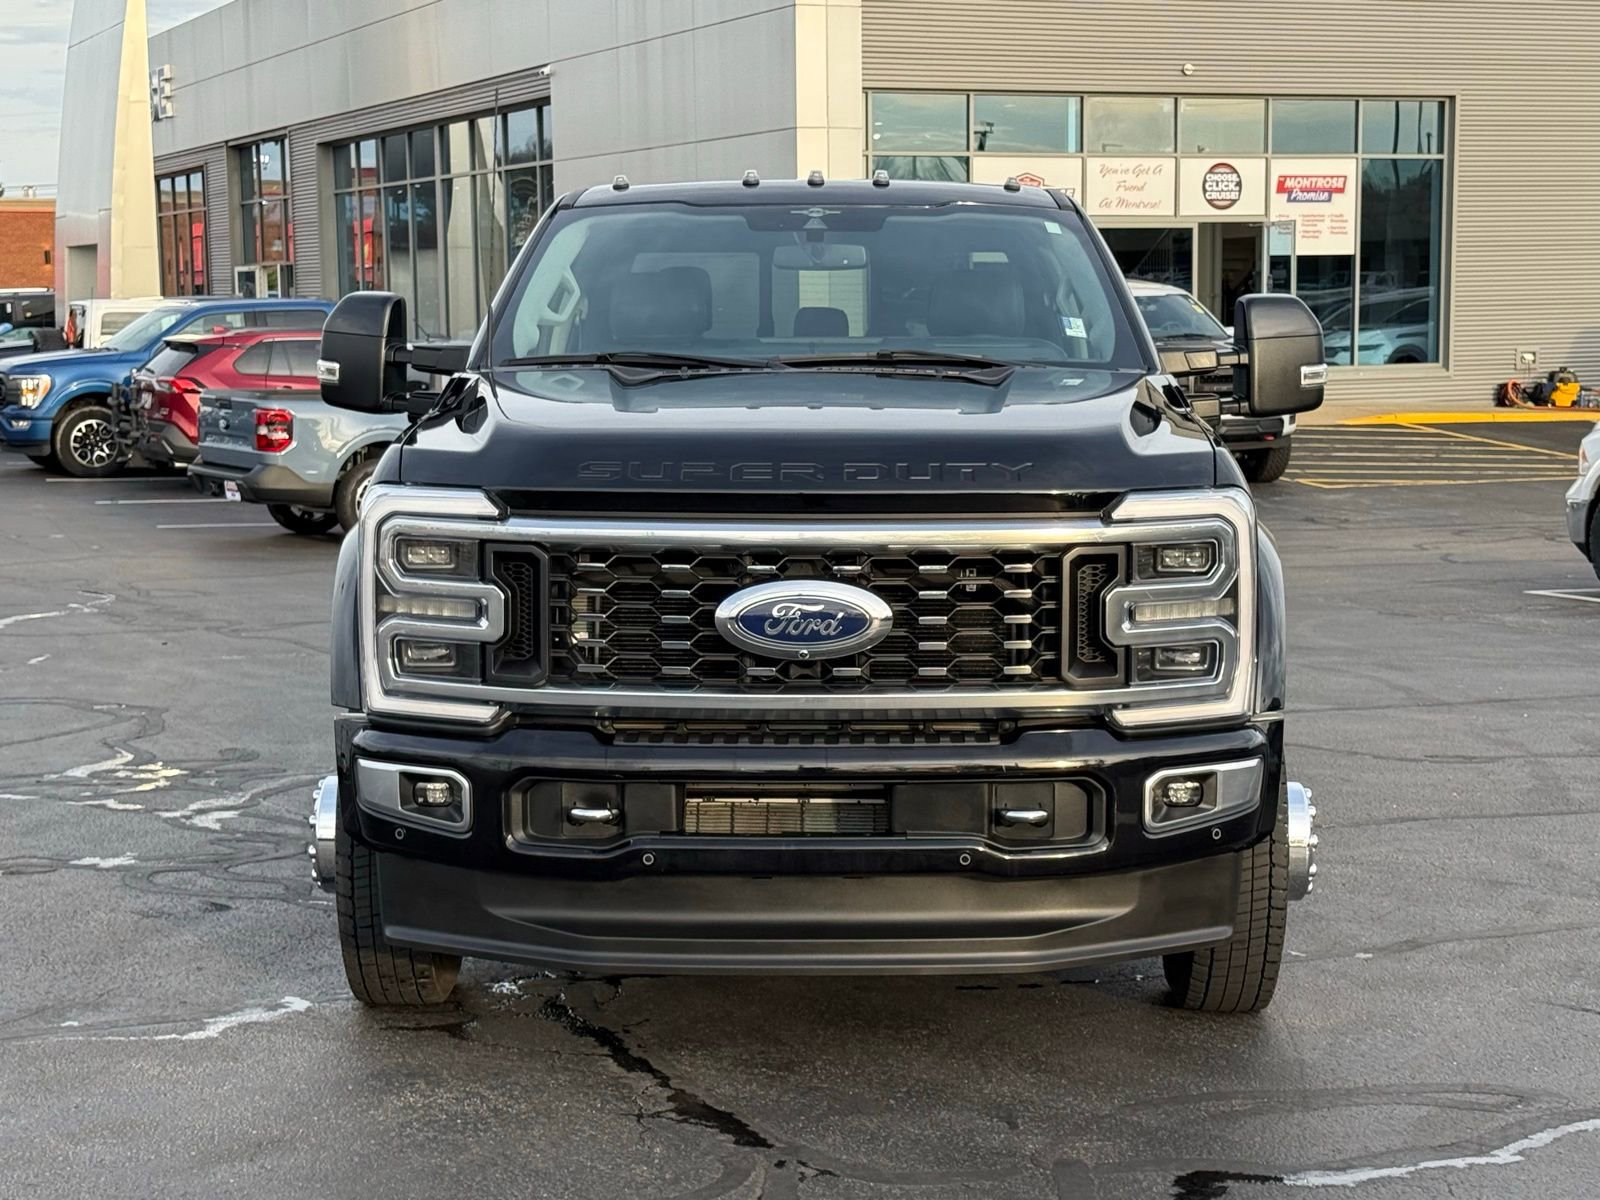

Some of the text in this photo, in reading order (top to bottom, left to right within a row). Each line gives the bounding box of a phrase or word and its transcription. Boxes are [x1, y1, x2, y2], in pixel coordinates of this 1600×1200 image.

[1152, 164, 1164, 176] A
[1115, 180, 1148, 192] Friend
[1283, 177, 1345, 189] MONTROSE
[1290, 189, 1330, 201] Promise
[577, 461, 1034, 482] SUPER DUTY
[764, 602, 845, 637] Ford
